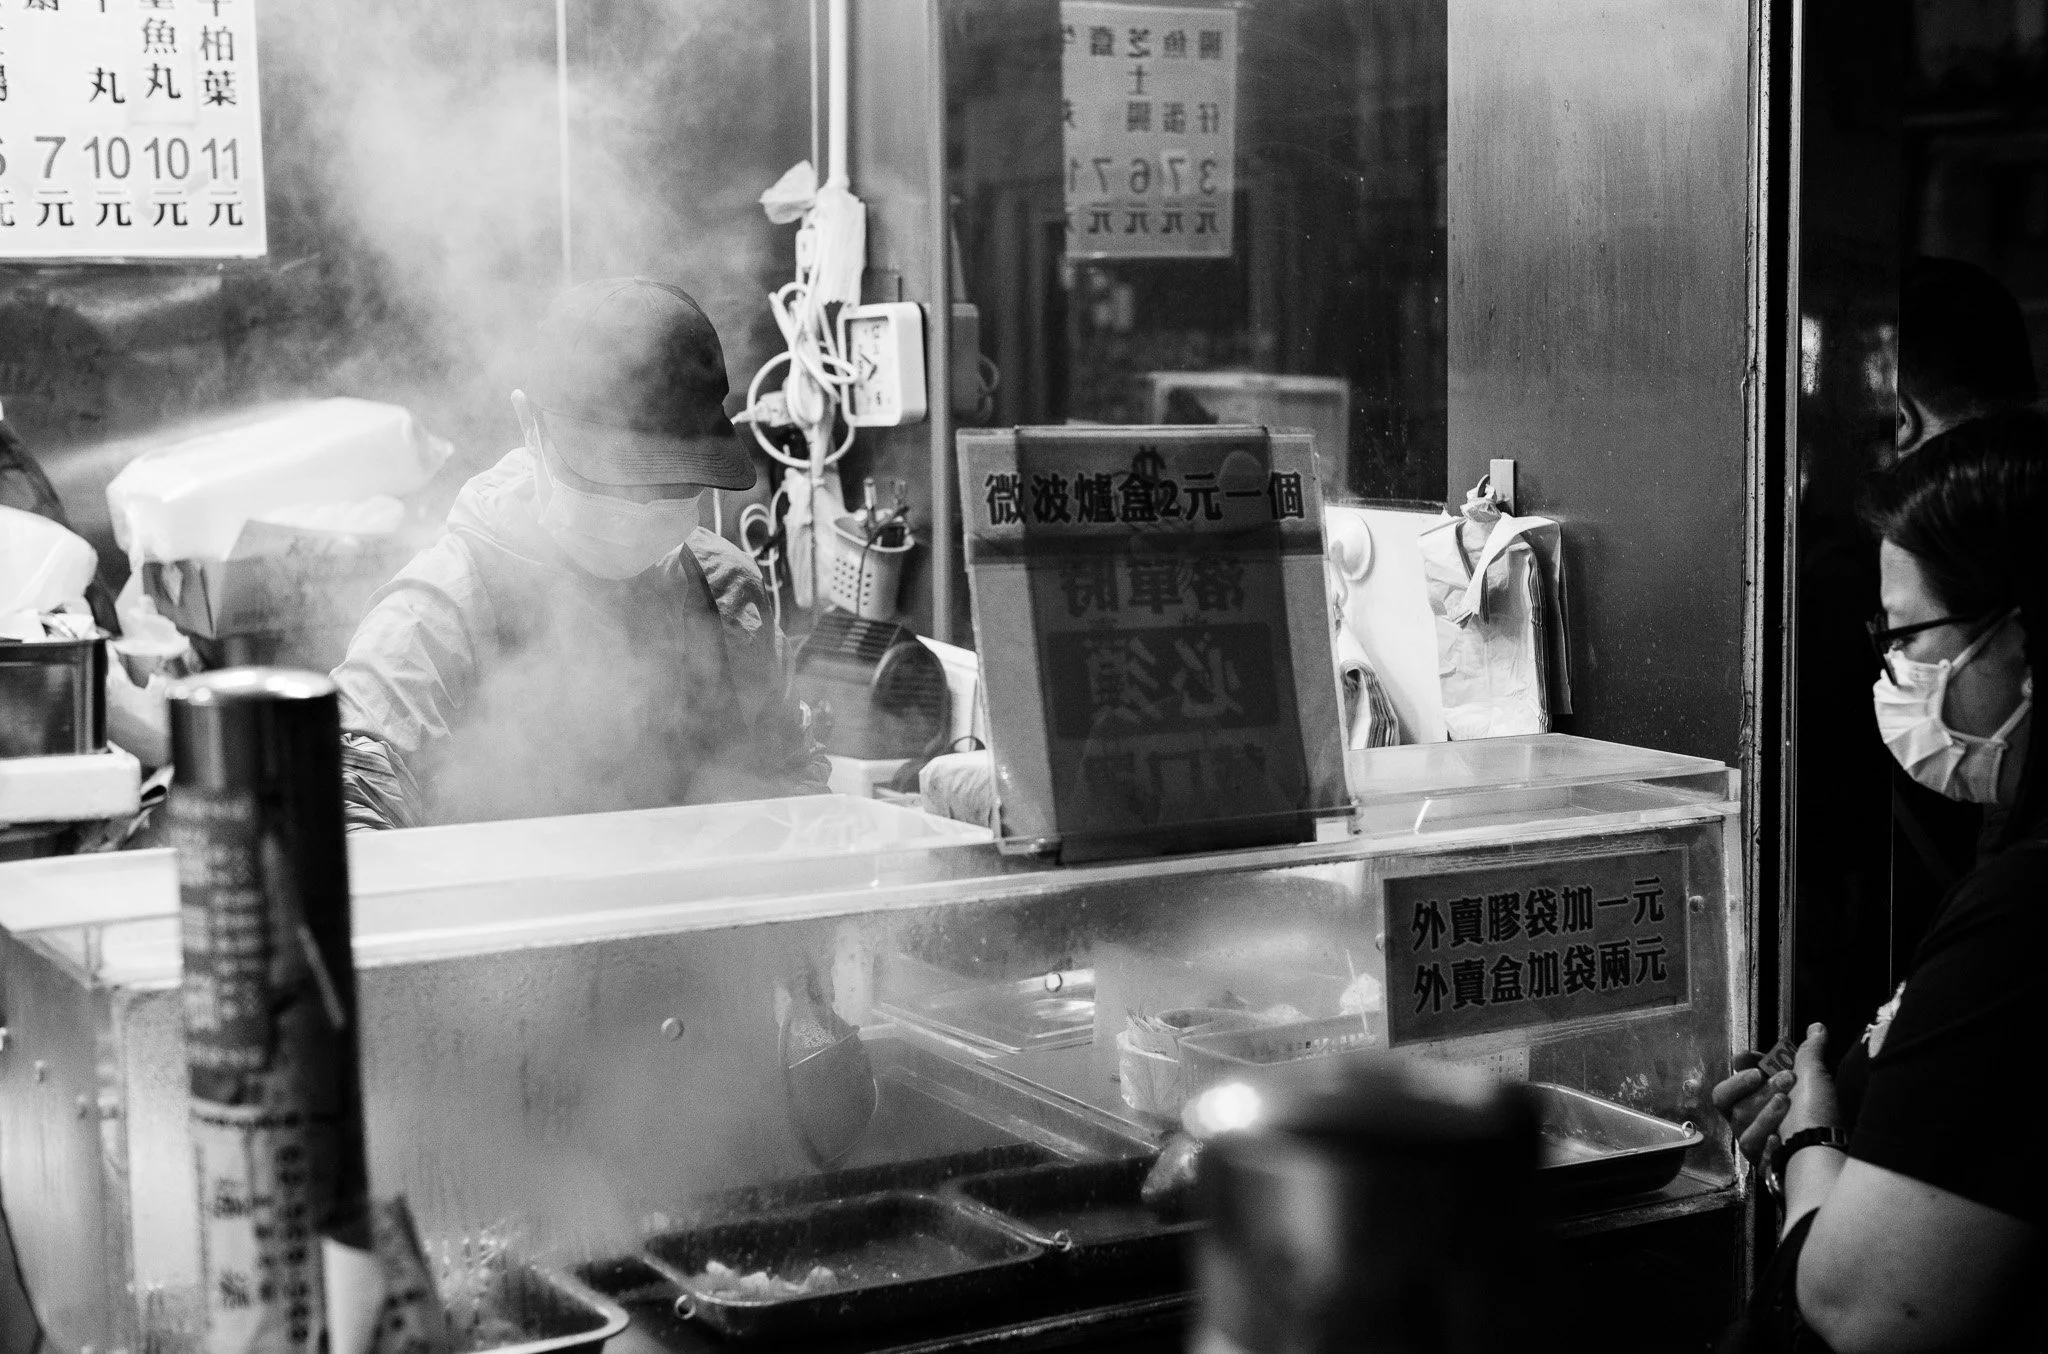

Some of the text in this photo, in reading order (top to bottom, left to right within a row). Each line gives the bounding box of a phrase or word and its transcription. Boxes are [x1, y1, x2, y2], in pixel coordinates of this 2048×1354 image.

[83, 135, 131, 180] 10
[143, 136, 190, 180] 10
[201, 137, 239, 180] 11
[34, 135, 75, 227] 7 元
[95, 190, 132, 227] 元
[152, 190, 189, 227] 元
[208, 190, 244, 227] 元
[985, 470, 1306, 525] 微波爐盒2元一個
[1410, 876, 1666, 951] 外賣膠袋加一元
[1412, 935, 1668, 1015] 外賣盒加袋兩元
